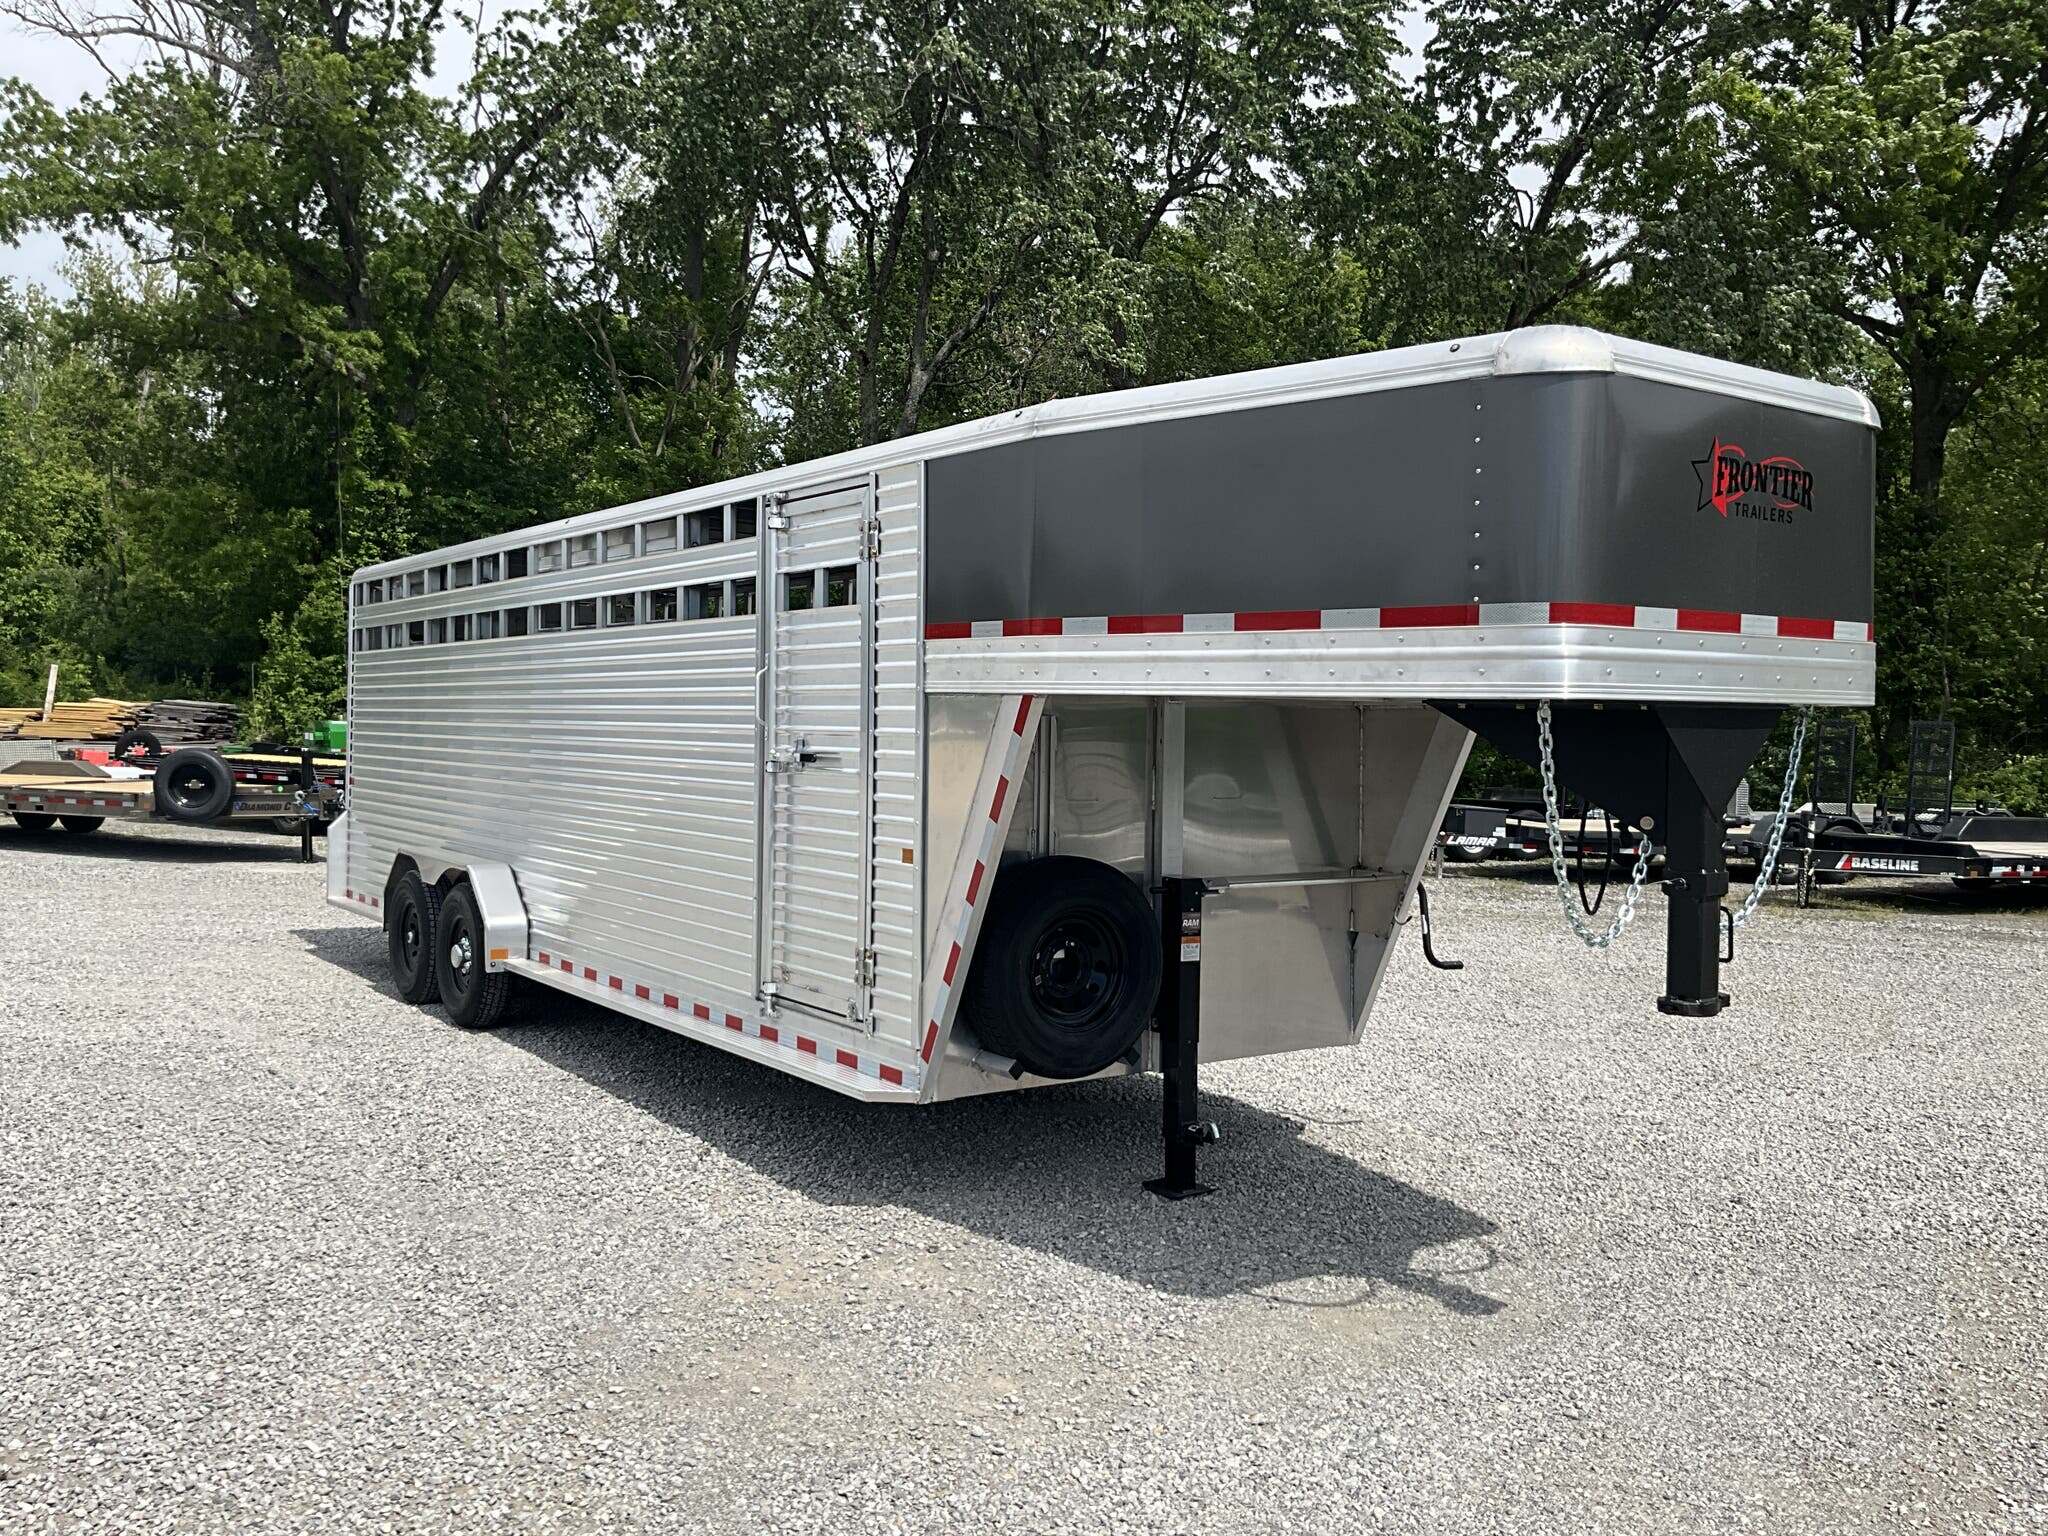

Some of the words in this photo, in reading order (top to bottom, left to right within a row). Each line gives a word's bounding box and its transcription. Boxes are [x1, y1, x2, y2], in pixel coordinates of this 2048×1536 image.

[1715, 455, 1814, 512] FRONTIER
[1734, 502, 1794, 524] TRAILERS
[239, 802, 282, 812] DIAMOND
[284, 802, 292, 811] C
[1446, 835, 1499, 847] LAMAR
[1851, 857, 1920, 871] BASELINE
[1182, 919, 1200, 927] RAM
